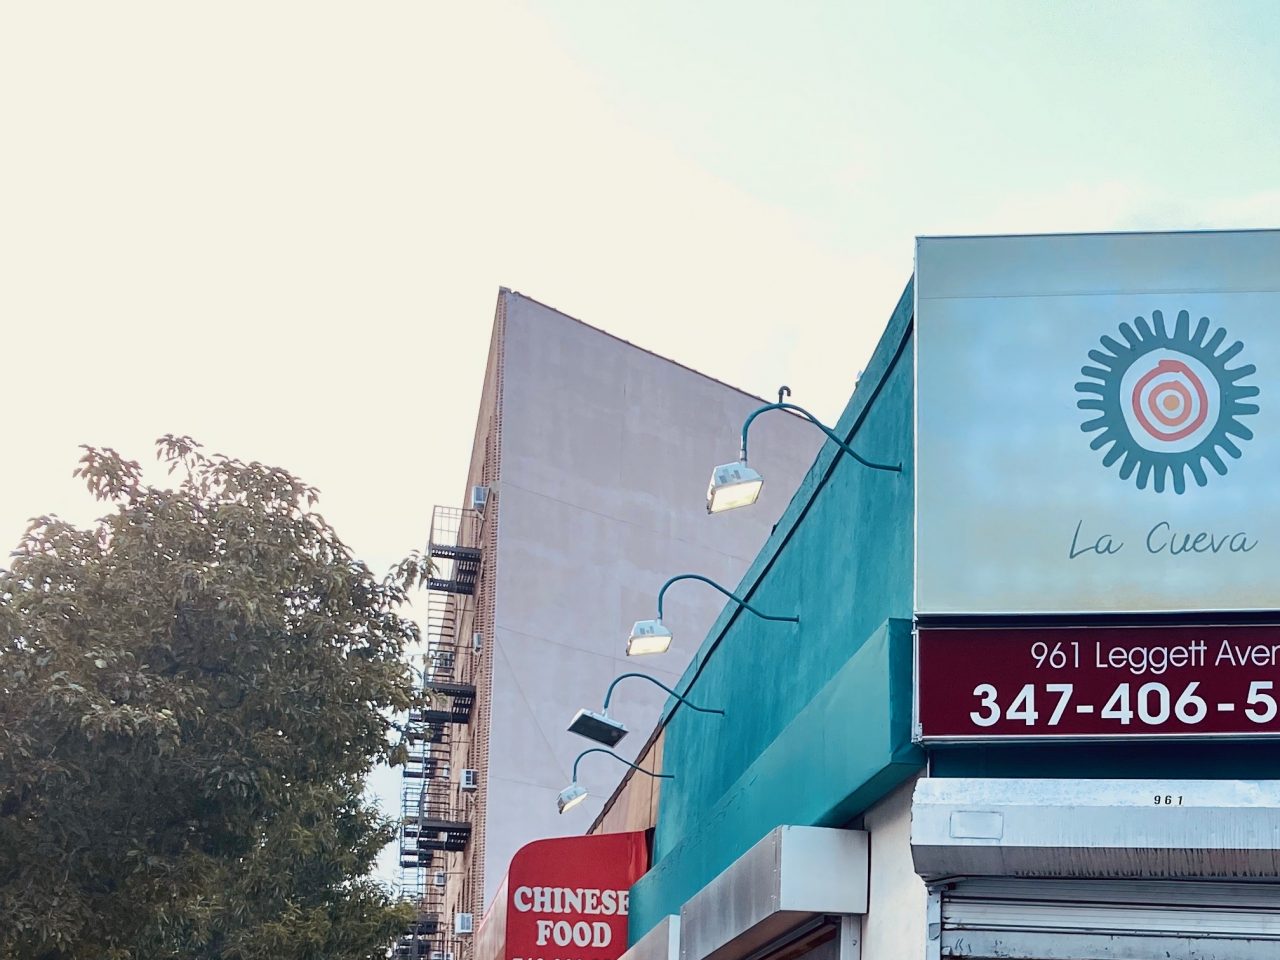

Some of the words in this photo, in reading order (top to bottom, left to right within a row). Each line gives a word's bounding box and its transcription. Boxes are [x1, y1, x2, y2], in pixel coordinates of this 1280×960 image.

[1069, 520, 1123, 560] La
[1146, 521, 1259, 555] Cueva
[1030, 642, 1081, 669] 961
[1096, 640, 1207, 673] Leggett
[513, 886, 630, 915] CHINESE
[536, 920, 612, 947] FOOD
